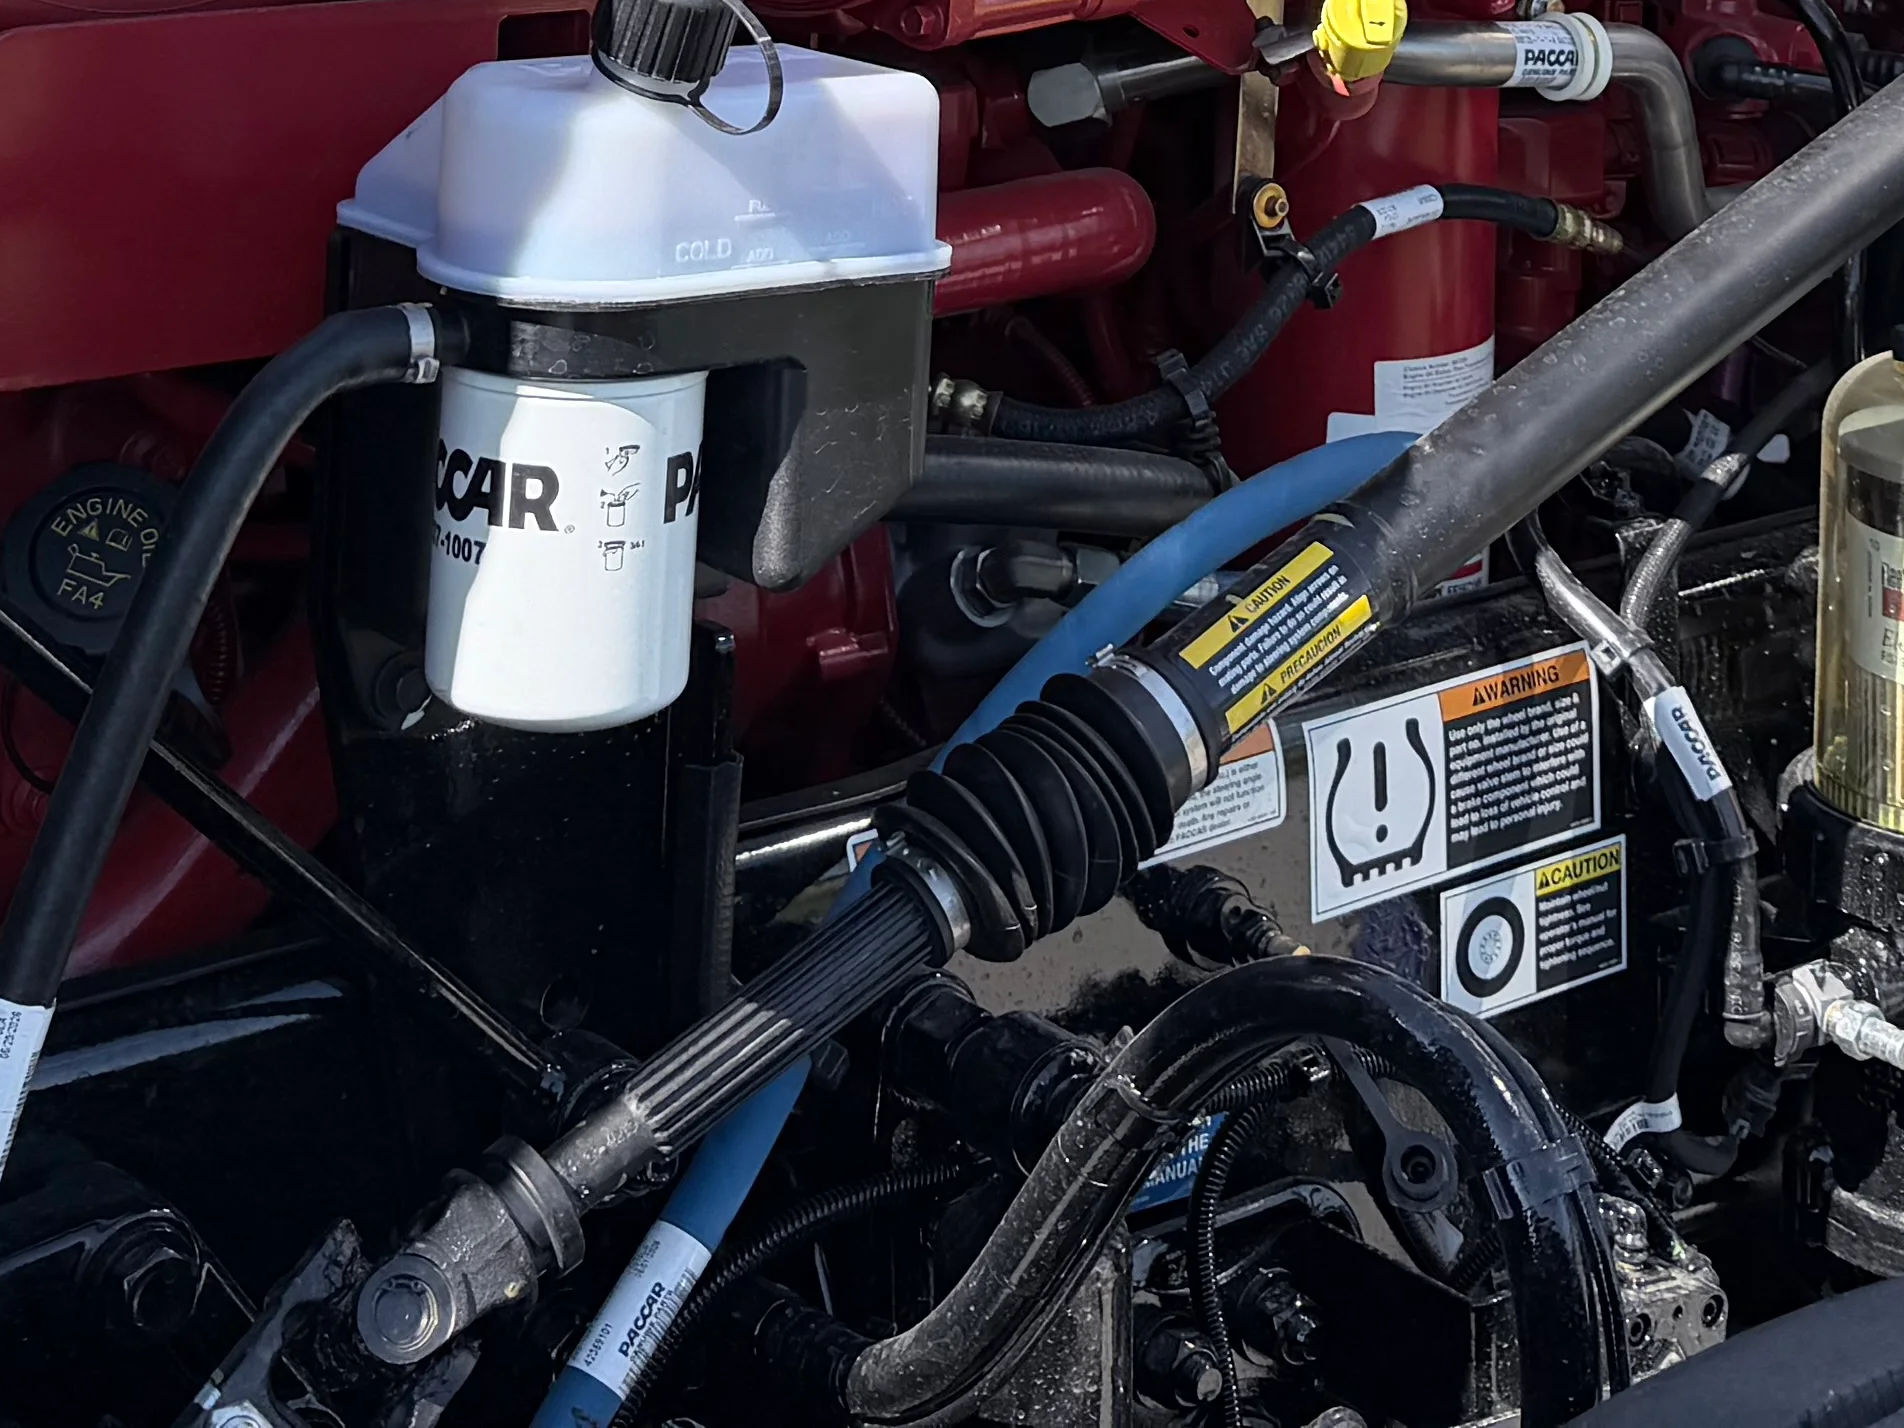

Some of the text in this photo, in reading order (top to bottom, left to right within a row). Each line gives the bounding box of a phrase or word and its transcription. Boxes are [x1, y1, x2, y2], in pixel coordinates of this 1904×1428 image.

[1524, 48, 1578, 67] PACCA
[675, 237, 733, 263] COLD
[51, 497, 148, 537] ENGINE
[56, 578, 105, 609] FA4
[1244, 573, 1290, 614] CAUTION
[1485, 665, 1559, 701] WARNING
[1551, 848, 1618, 885] CAUTION
[617, 1281, 666, 1357] PACCAR
